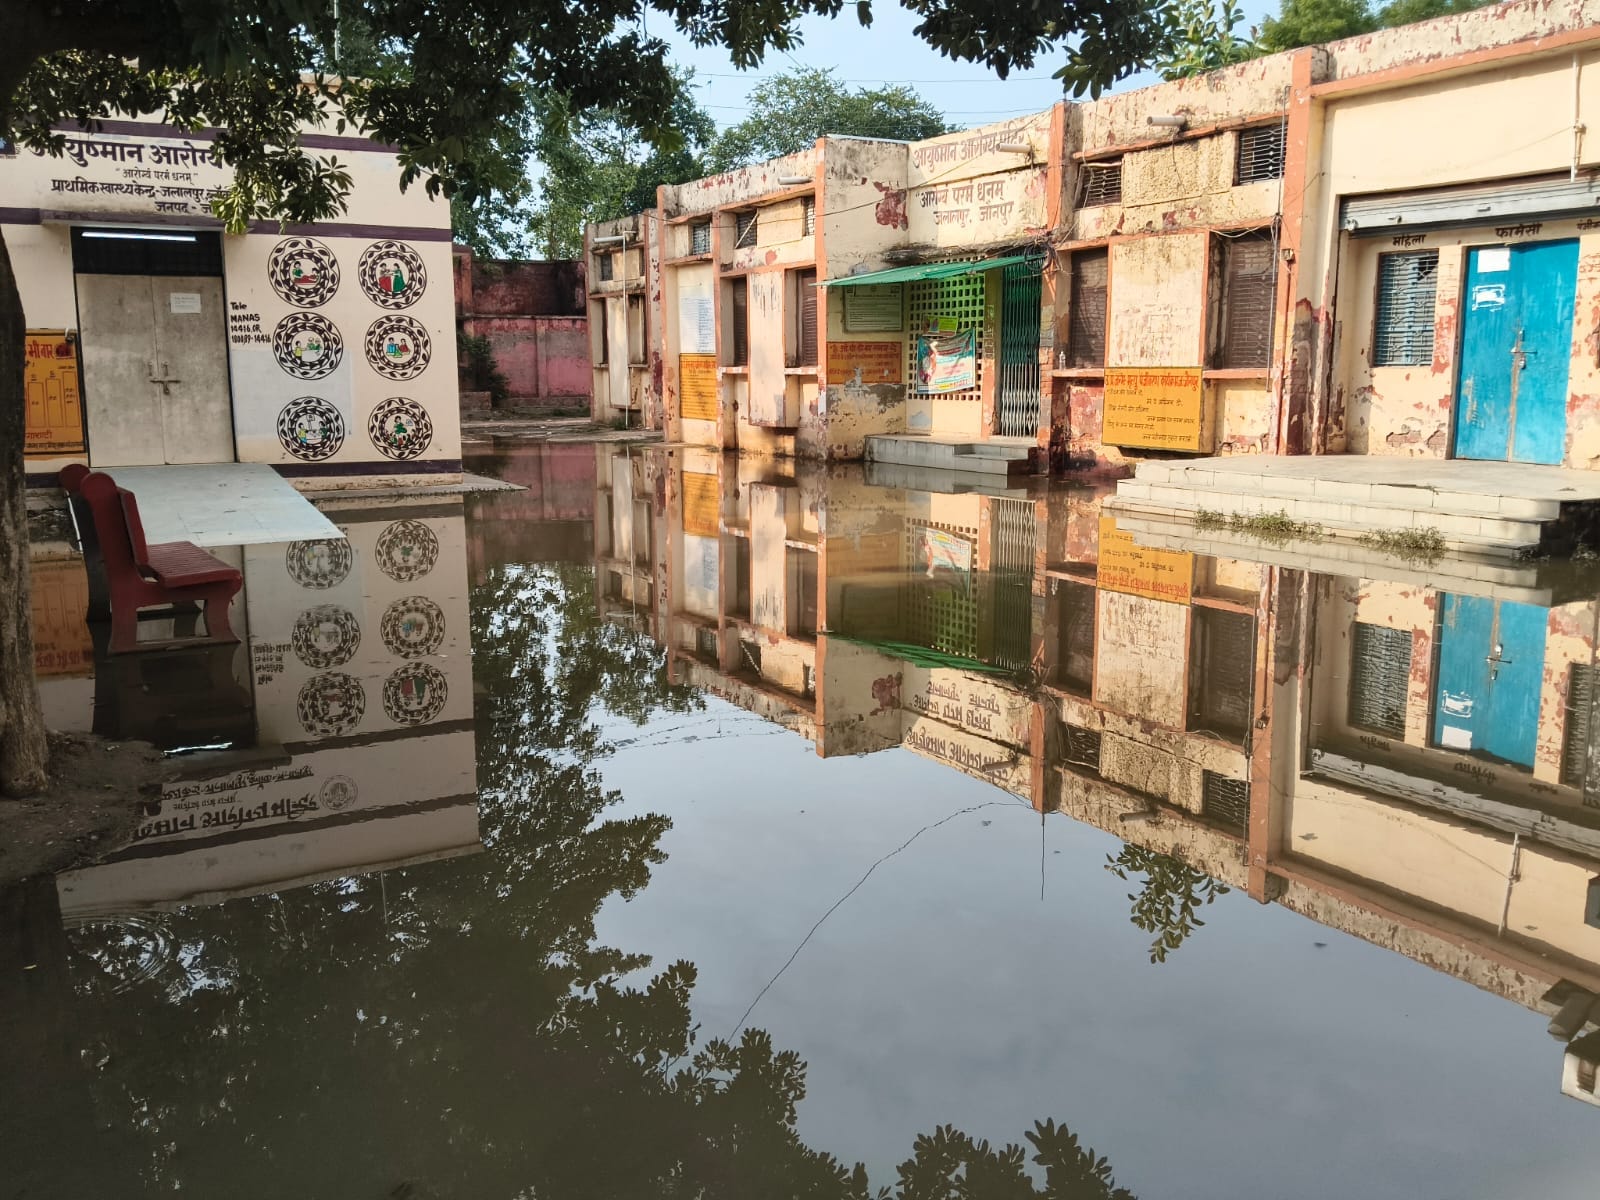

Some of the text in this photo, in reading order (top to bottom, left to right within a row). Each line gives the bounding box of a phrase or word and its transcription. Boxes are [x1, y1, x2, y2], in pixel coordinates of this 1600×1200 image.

[51, 176, 99, 194] प्राथमिक
[1392, 234, 1427, 247] महिला
[230, 301, 247, 310] Tele
[230, 314, 261, 323] MANAS
